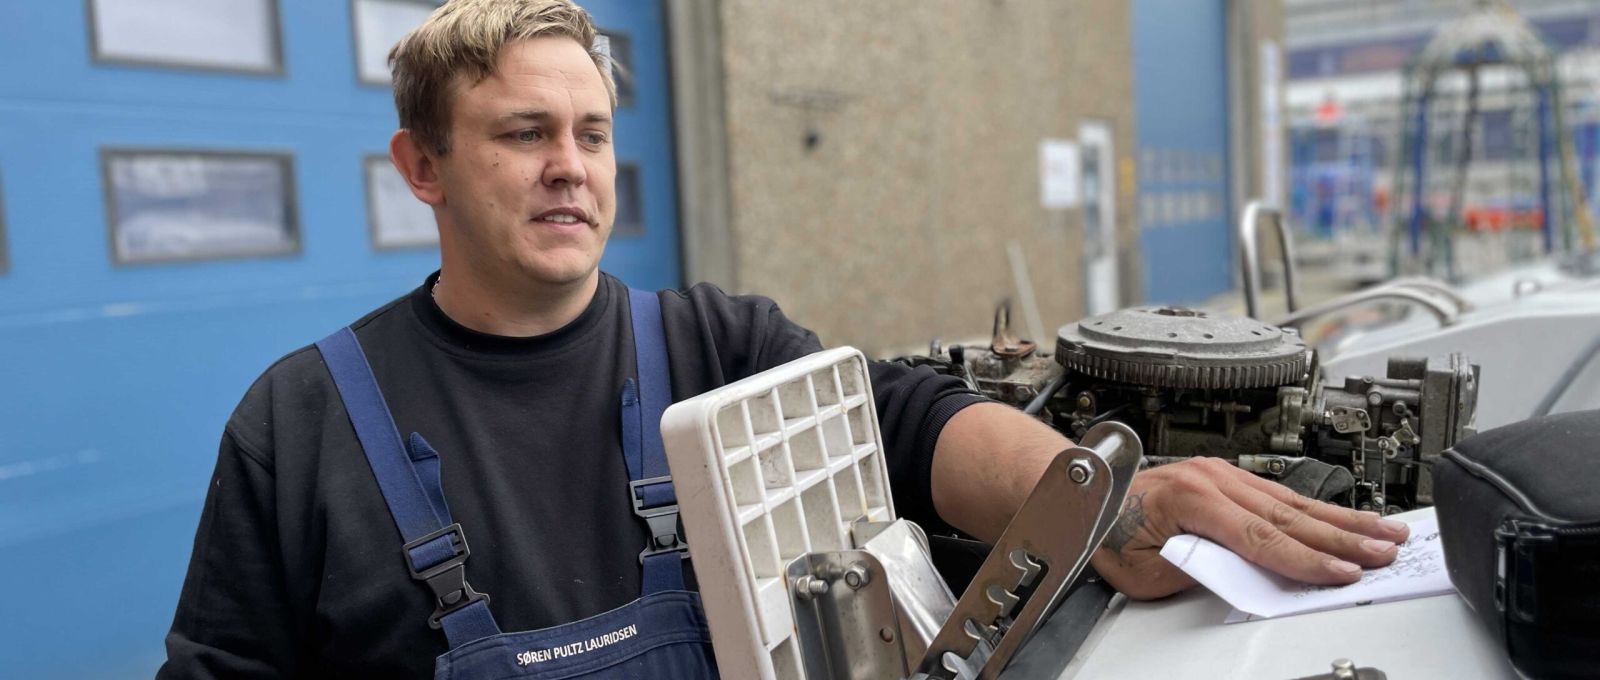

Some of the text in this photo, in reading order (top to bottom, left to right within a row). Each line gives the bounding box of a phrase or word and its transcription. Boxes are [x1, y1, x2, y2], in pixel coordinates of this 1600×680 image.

[516, 624, 637, 665] SØREN PULTZ LAURIDSEN
